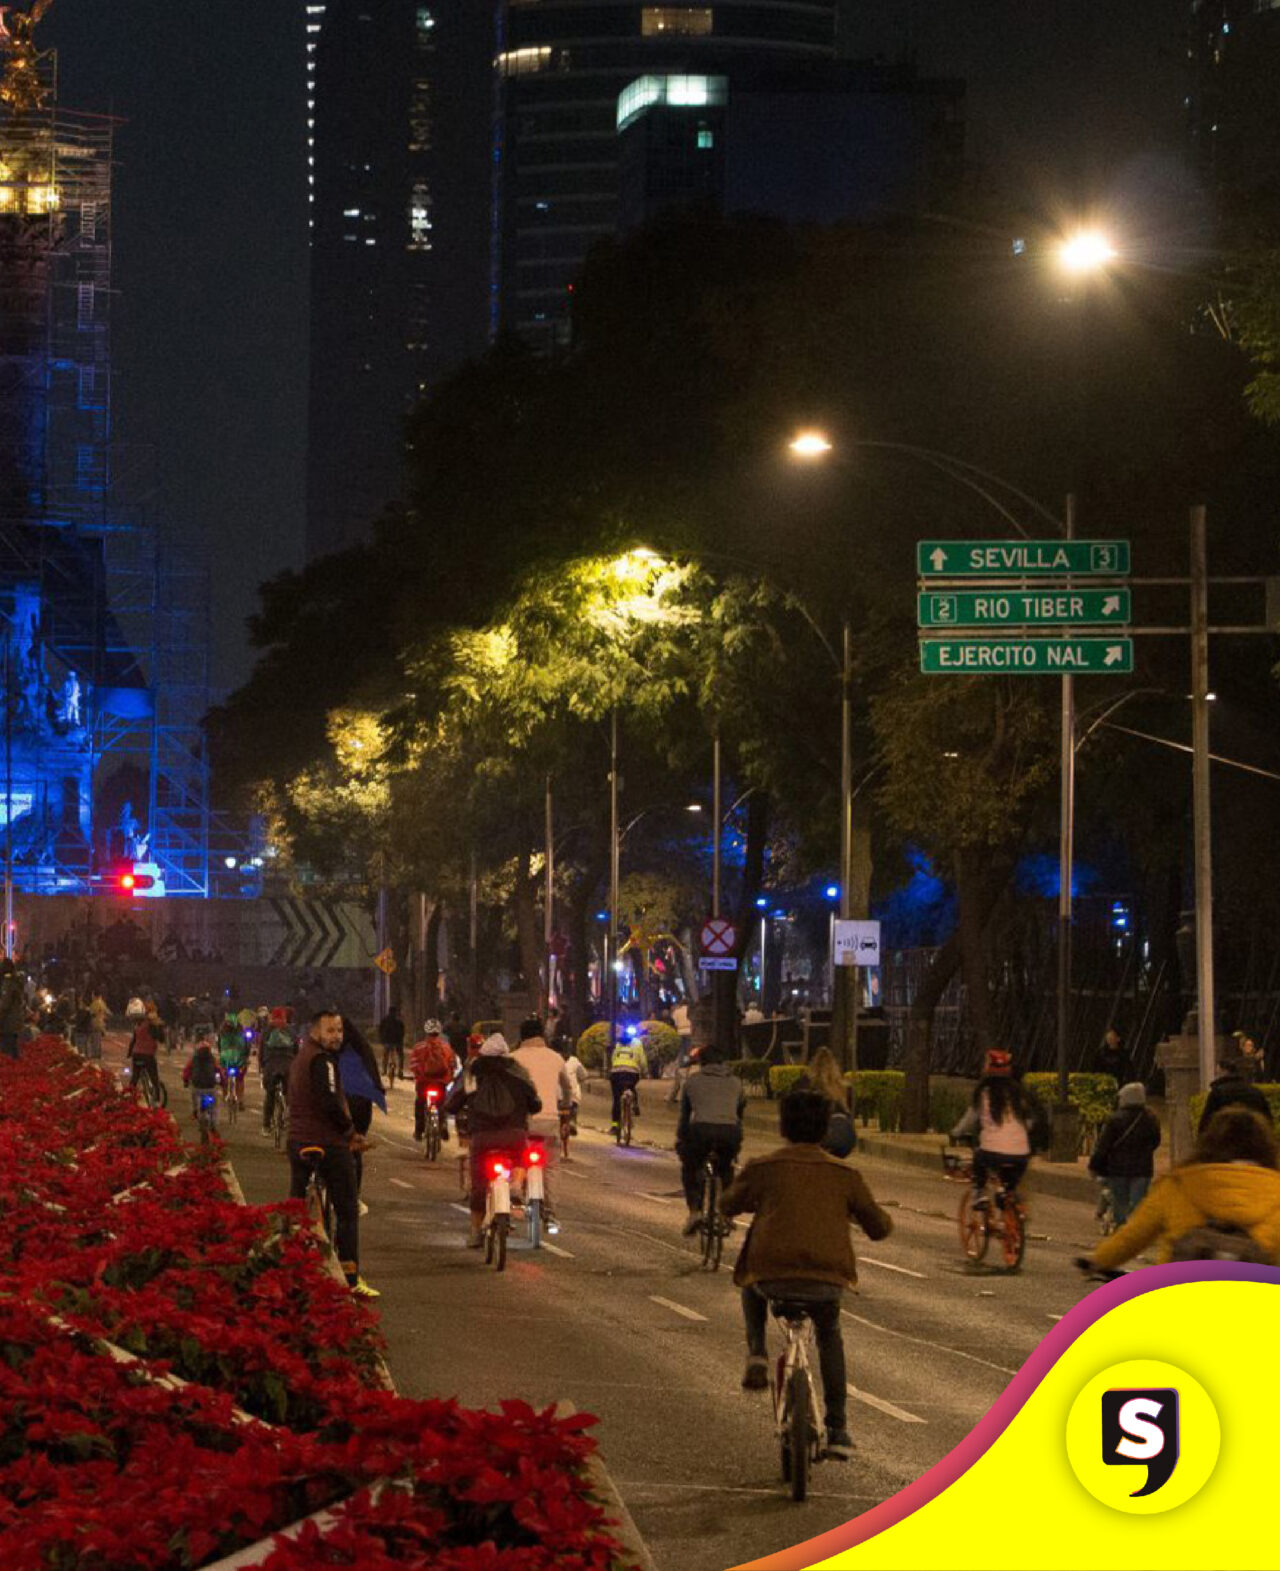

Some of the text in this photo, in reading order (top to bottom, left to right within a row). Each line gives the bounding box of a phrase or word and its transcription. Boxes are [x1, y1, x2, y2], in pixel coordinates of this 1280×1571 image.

[970, 548, 1070, 568] SEVILLA
[1099, 551, 1111, 565] 3
[938, 602, 950, 617] 2
[974, 598, 1084, 618] RIO TIBER
[939, 645, 1089, 666] EJERCITO NAL
